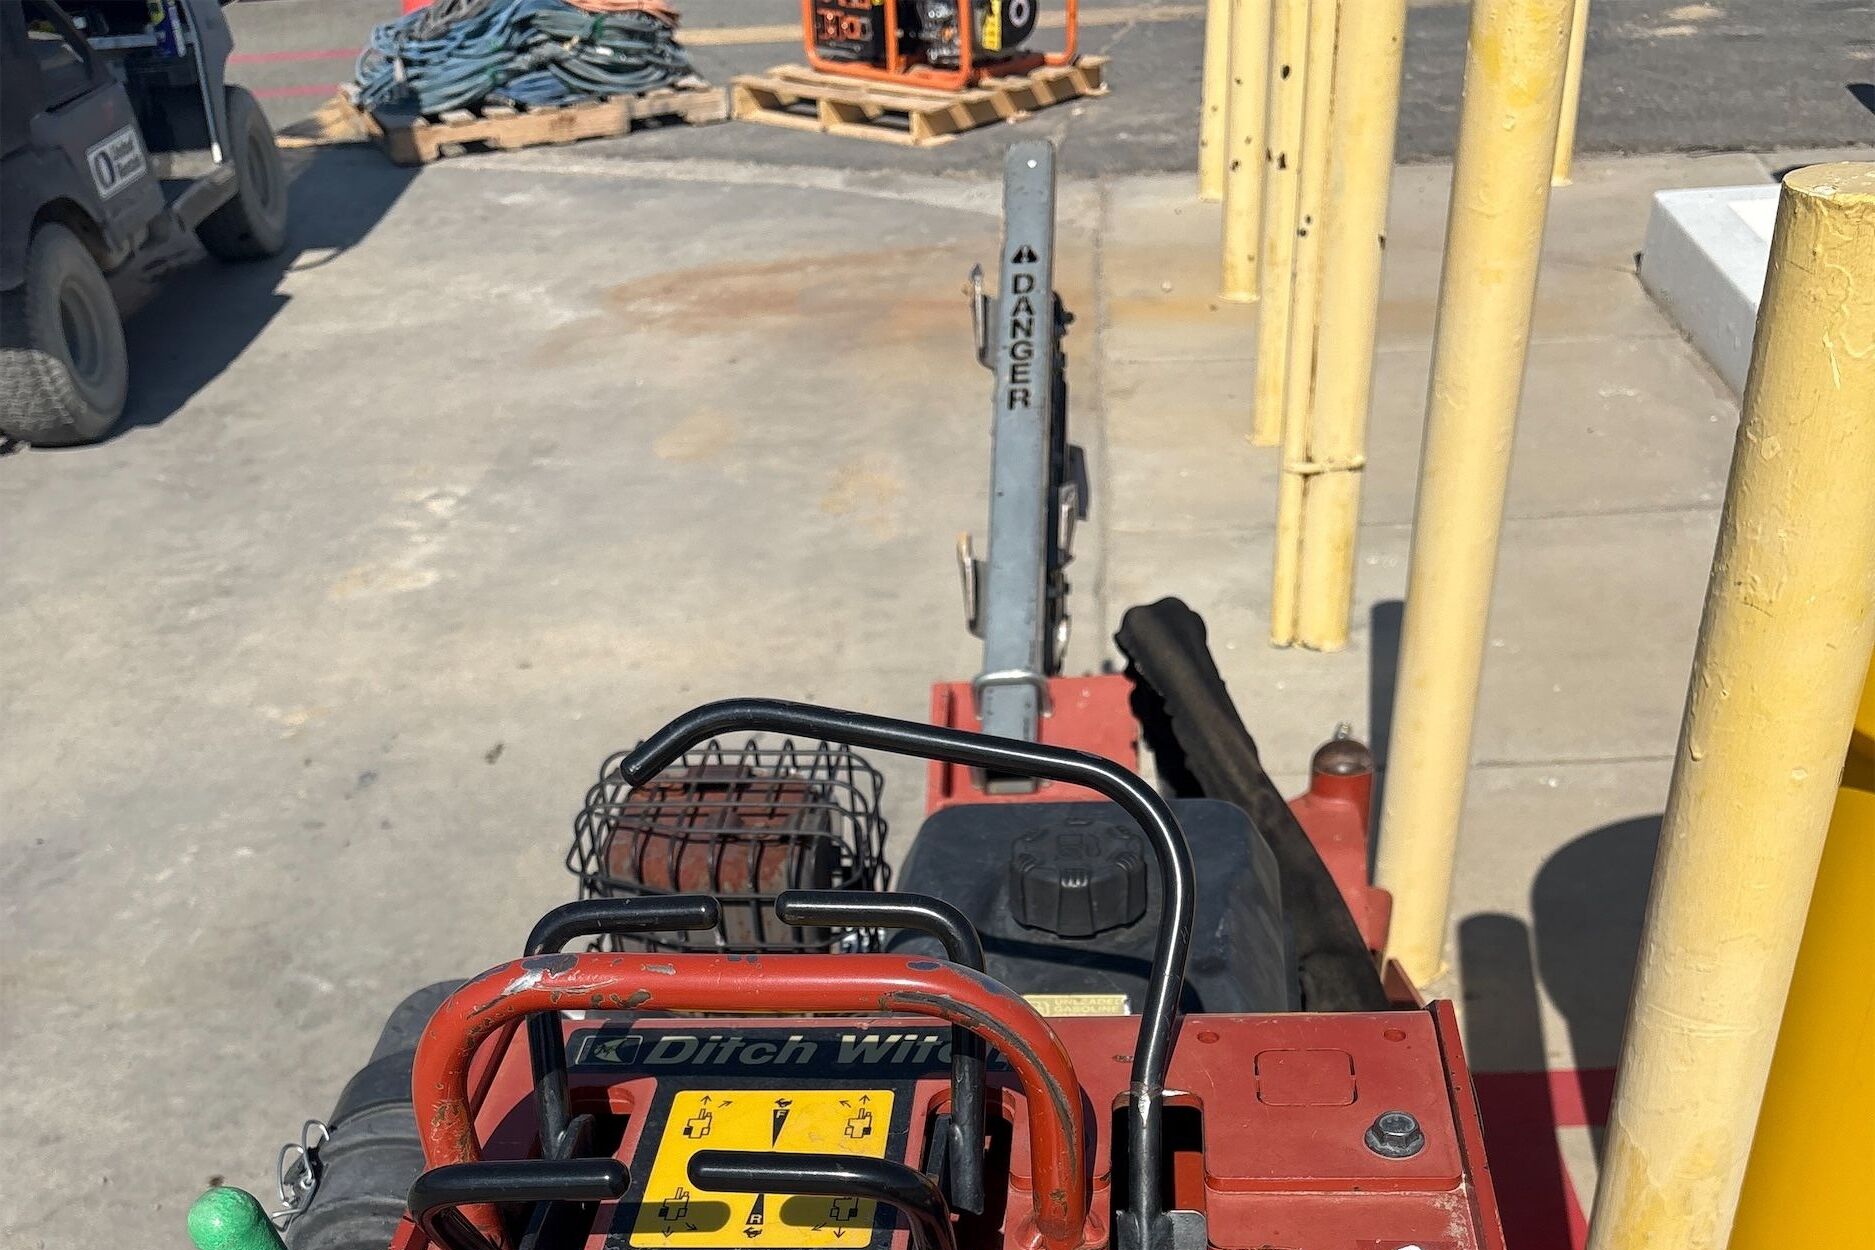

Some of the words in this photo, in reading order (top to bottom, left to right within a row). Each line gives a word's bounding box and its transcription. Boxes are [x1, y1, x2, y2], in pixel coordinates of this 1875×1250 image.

[1007, 273, 1036, 411] DANGER
[643, 1035, 820, 1065] Ditch
[750, 1214, 762, 1225] R
